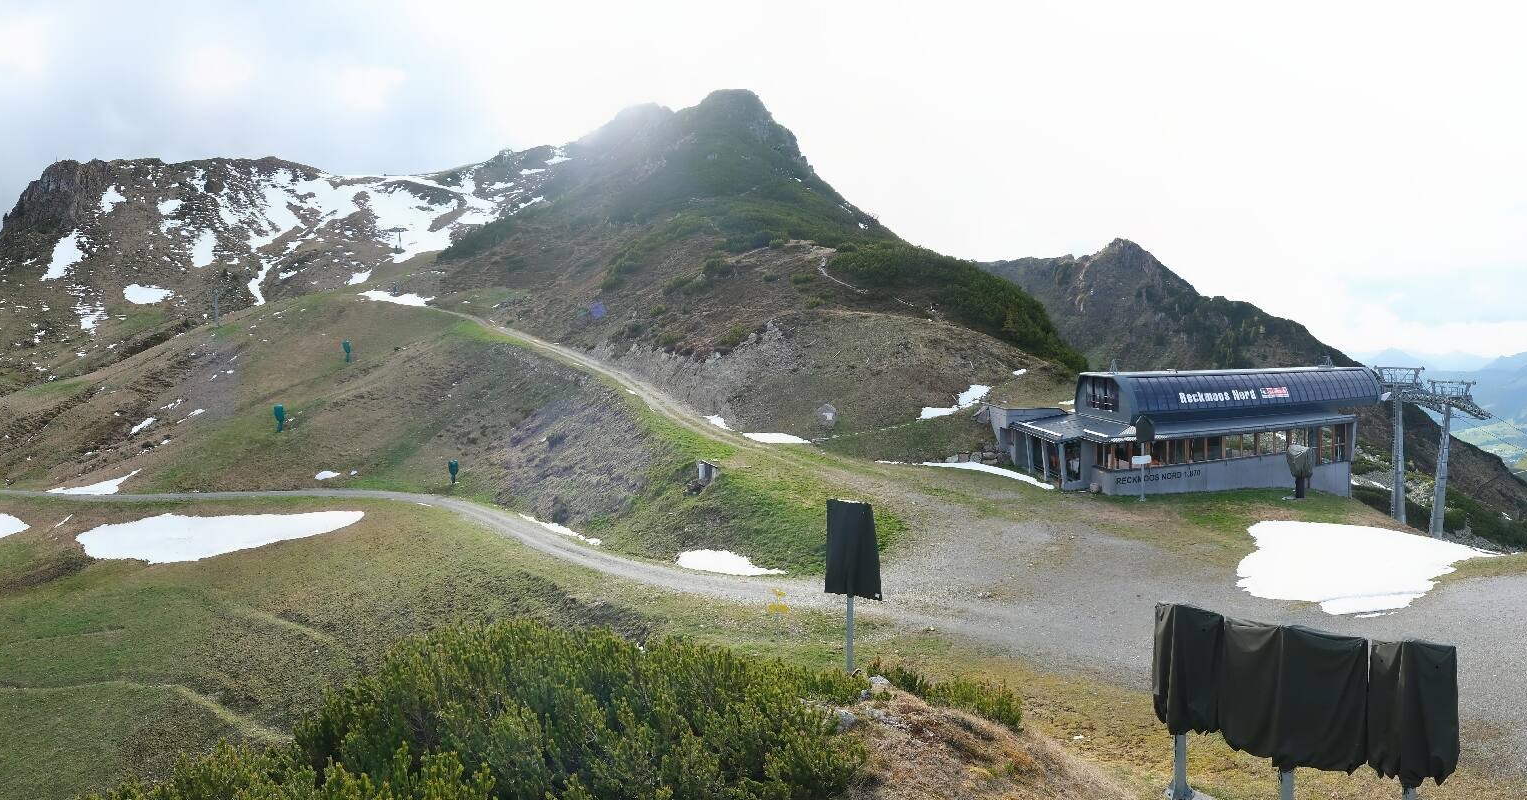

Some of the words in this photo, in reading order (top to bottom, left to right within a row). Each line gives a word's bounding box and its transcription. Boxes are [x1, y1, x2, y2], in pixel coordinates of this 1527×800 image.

[1179, 391, 1230, 403] Reckmoos
[1232, 389, 1256, 401] Nord
[1162, 471, 1182, 481] NORD
